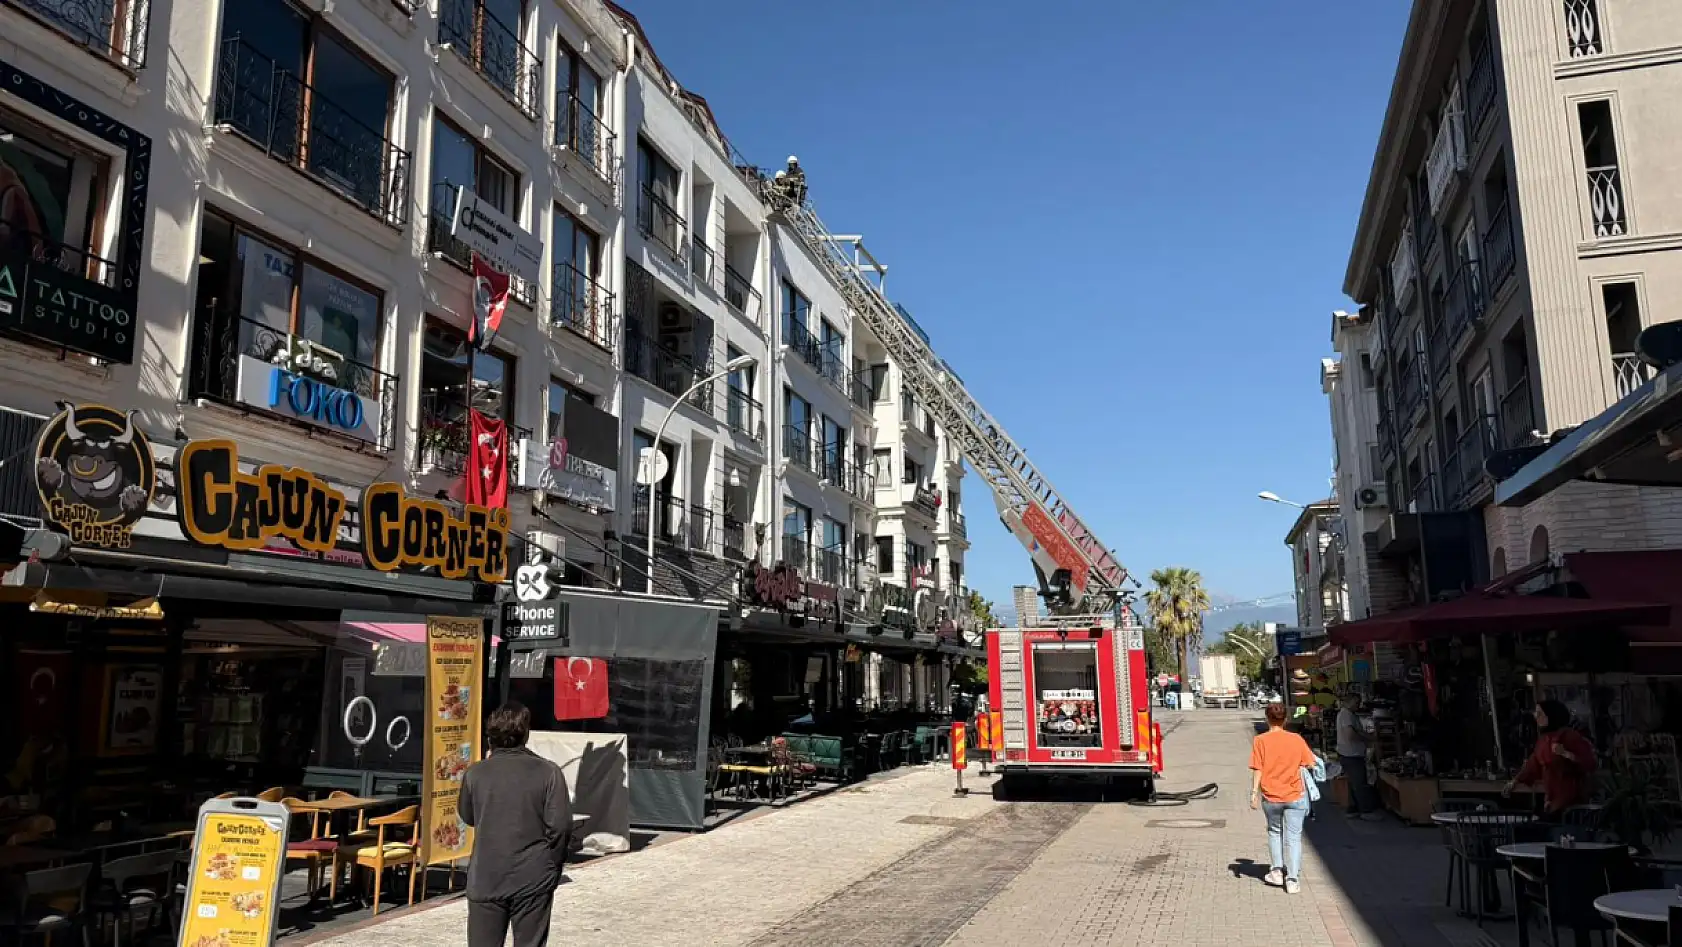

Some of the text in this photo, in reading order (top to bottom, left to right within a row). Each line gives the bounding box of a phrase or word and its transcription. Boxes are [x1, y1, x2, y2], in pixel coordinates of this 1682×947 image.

[33, 278, 130, 327] TATTOO
[35, 303, 127, 344] STUDIO
[268, 367, 363, 430] FOKO
[50, 497, 99, 526] CAJUN
[186, 445, 505, 578] CAJUN CORNER
[71, 520, 131, 548] CORNER
[505, 624, 555, 637] SERVICE
[506, 605, 555, 621] iPhone
